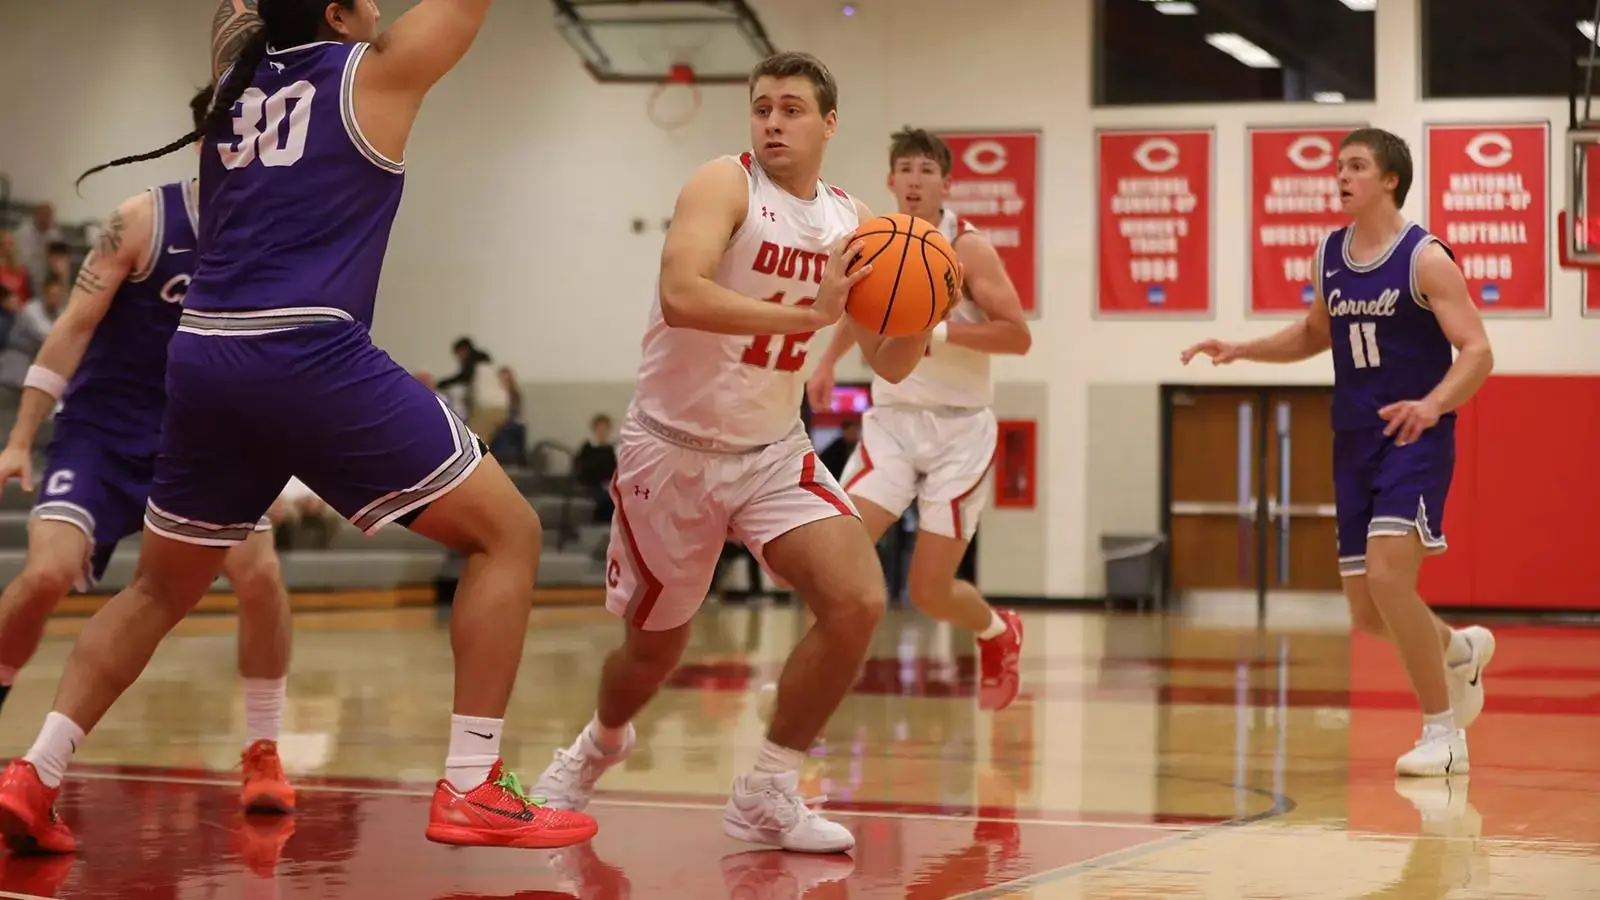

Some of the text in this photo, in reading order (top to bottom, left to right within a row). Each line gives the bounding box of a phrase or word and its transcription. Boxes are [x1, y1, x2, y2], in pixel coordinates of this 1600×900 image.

[217, 80, 317, 171] 30
[1449, 173, 1524, 192] NATIONAL
[1446, 221, 1528, 244] SOFTBALL
[752, 240, 830, 284] DUTC
[160, 273, 192, 304] C
[1328, 288, 1400, 316] Cornell
[1348, 322, 1380, 369] 11
[46, 469, 75, 496] C
